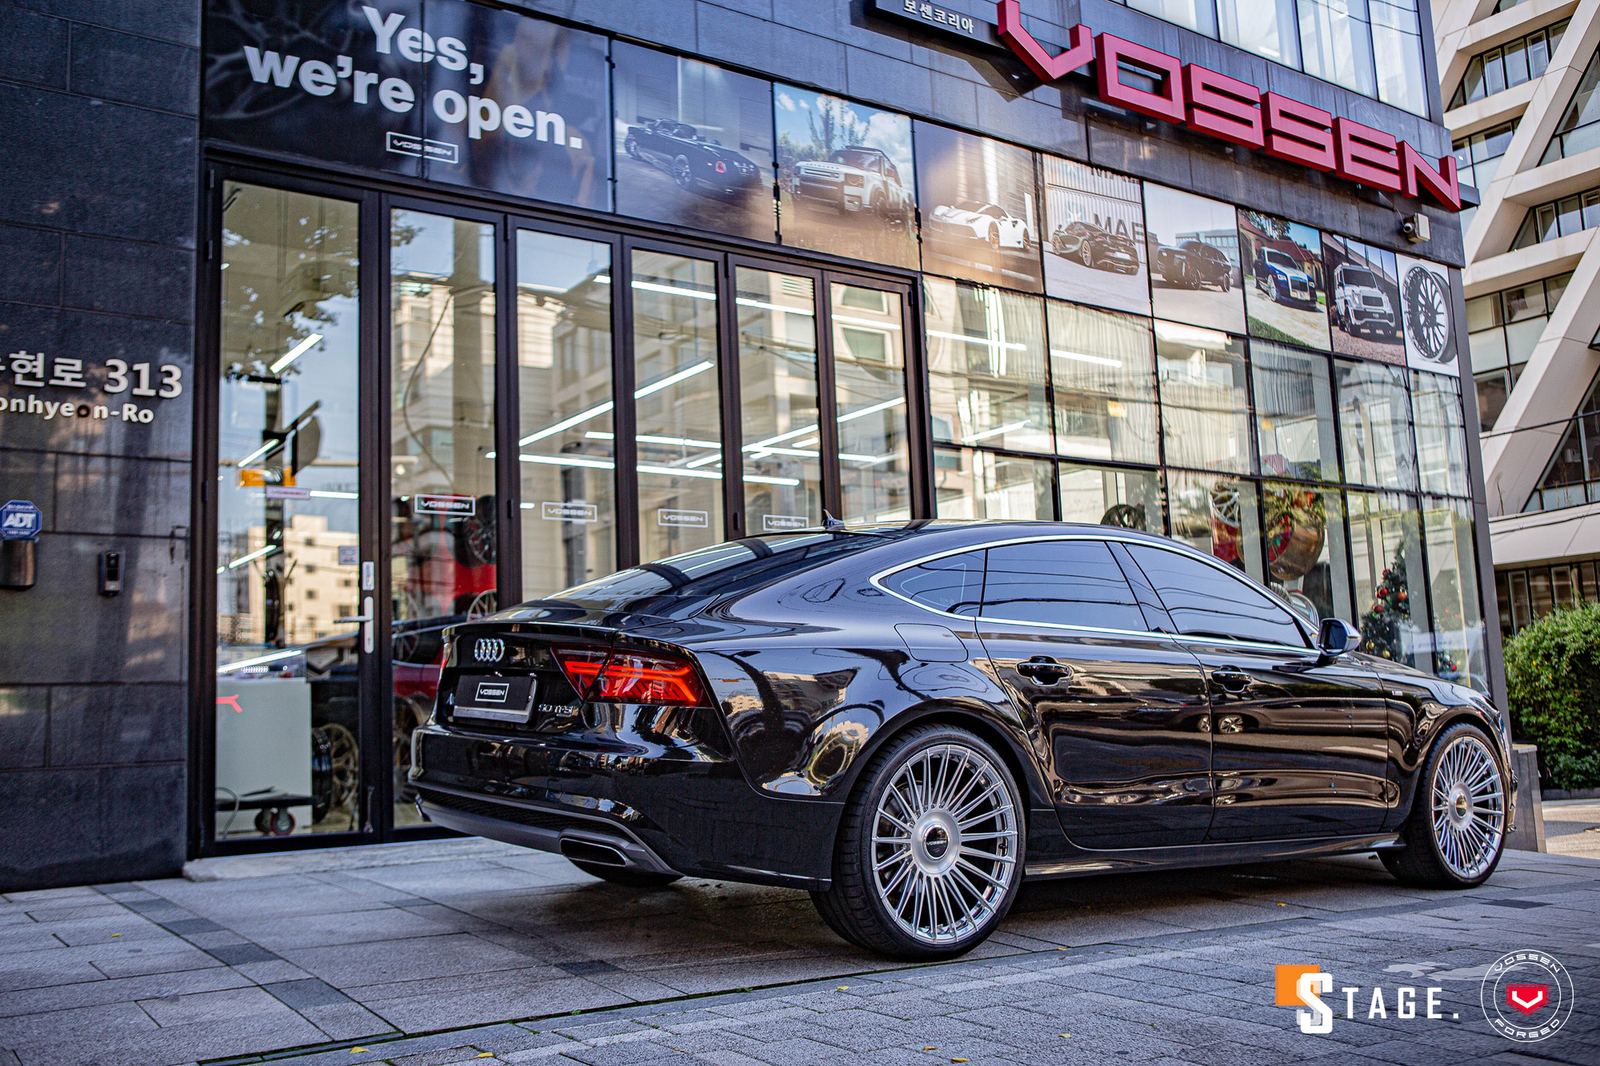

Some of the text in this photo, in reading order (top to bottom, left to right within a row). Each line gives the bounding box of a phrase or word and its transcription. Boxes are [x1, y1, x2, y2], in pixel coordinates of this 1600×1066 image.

[903, 0, 974, 34] 보센코리아
[362, 5, 484, 85] Yes,
[243, 45, 583, 149] we're open.
[998, 0, 1462, 213] VOSSEN
[393, 139, 452, 156] VOSSEN
[0, 350, 183, 398] 현로 313
[420, 500, 470, 509] VOSSEN
[547, 508, 593, 516] VOSSEN
[2, 512, 37, 529] ADT
[662, 514, 704, 522] VOSSEN
[767, 519, 806, 528] VOSSEN
[480, 688, 505, 696] VOSSEN
